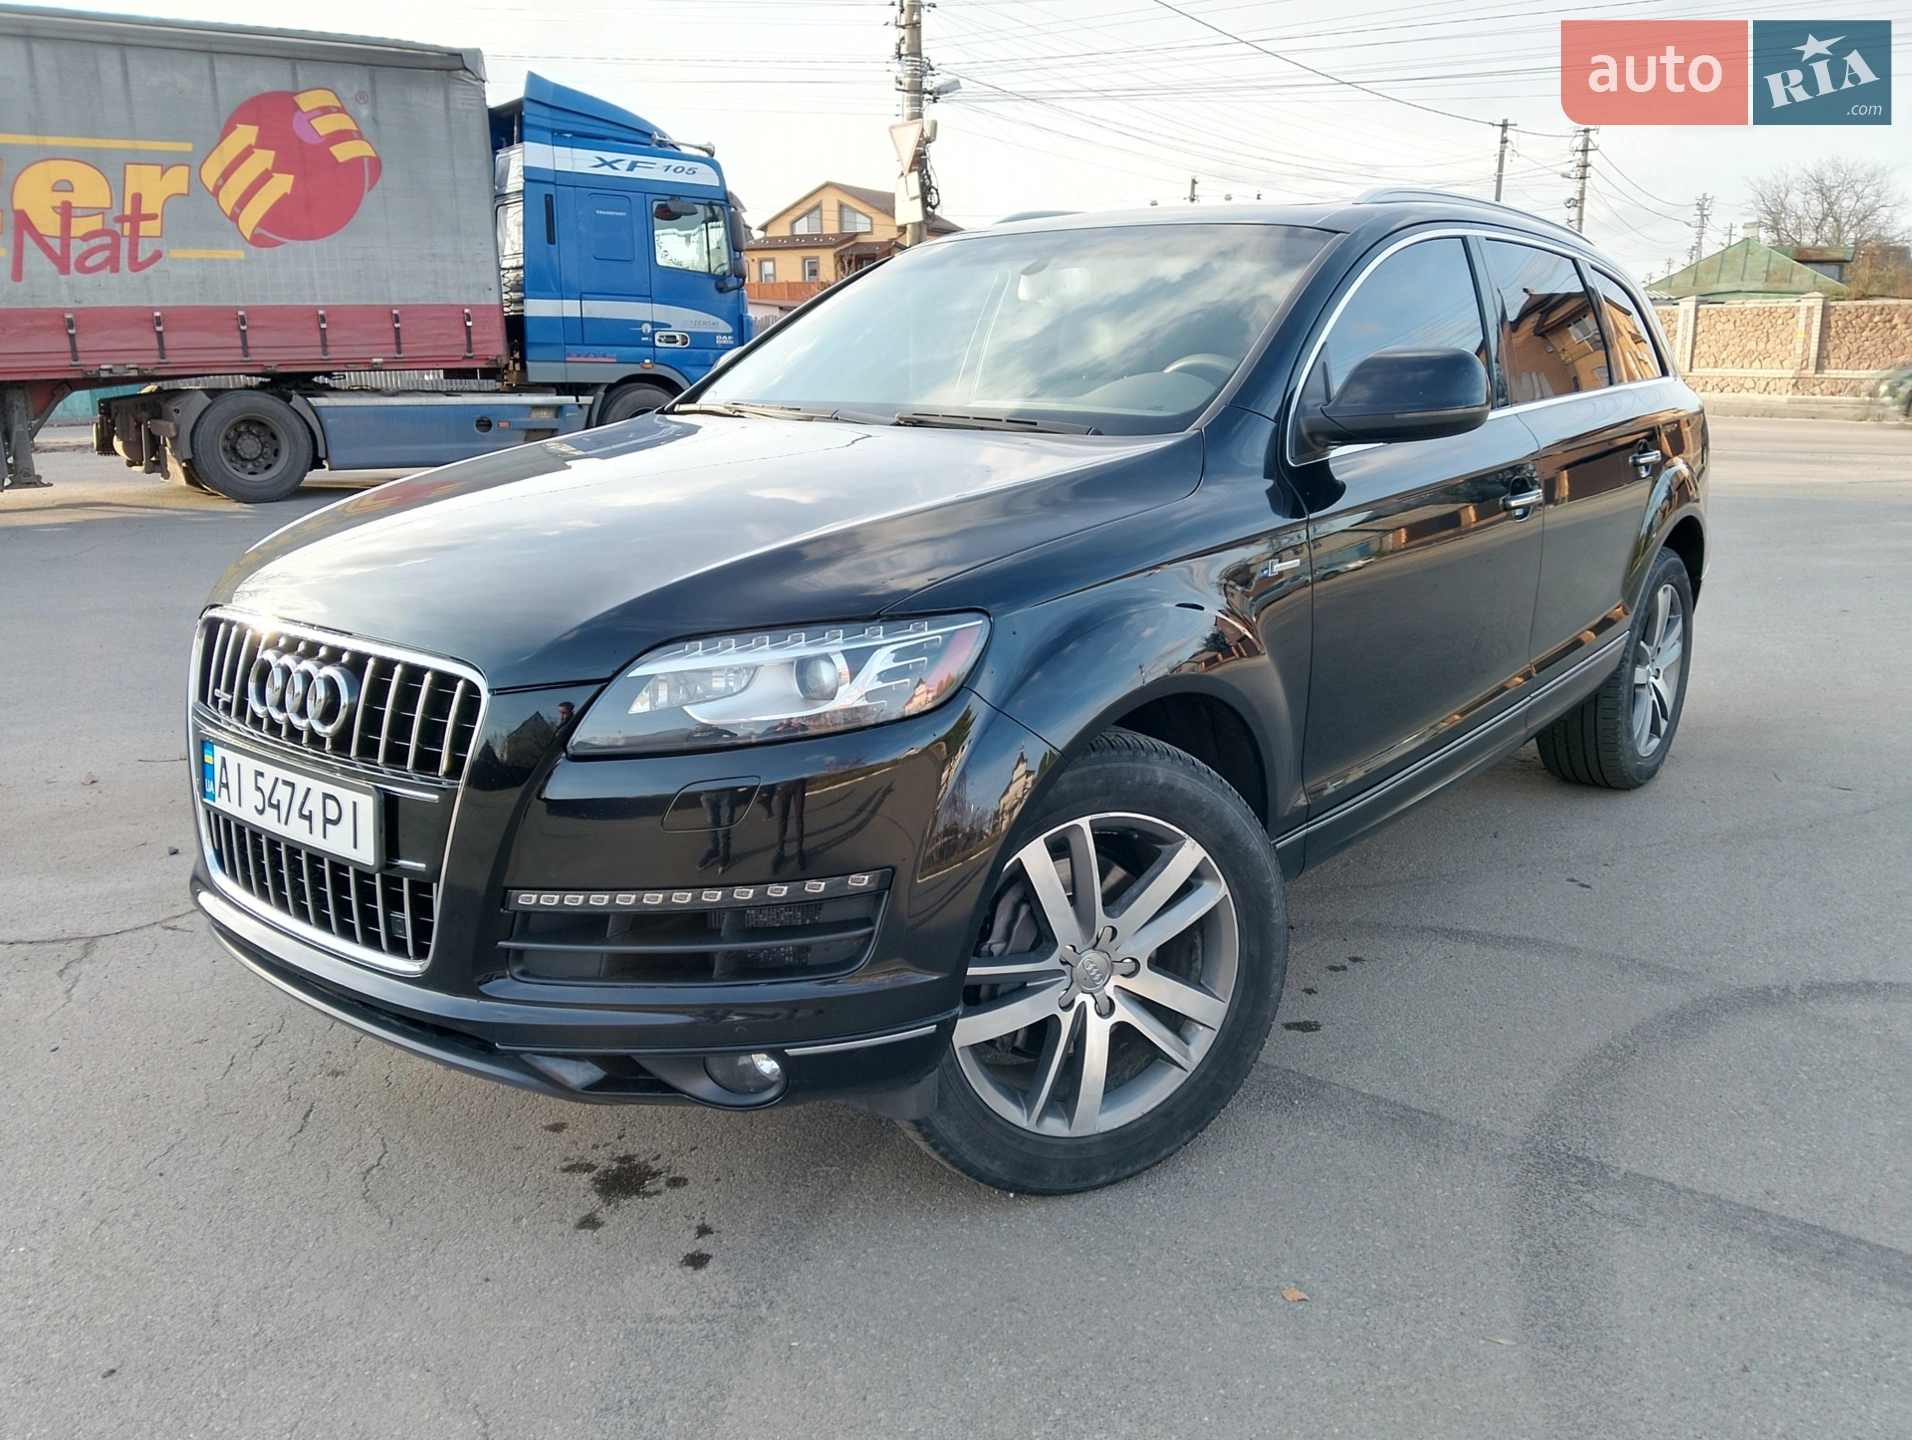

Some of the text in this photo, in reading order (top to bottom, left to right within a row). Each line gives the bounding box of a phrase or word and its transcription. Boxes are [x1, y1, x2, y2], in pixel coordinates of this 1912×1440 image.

[588, 156, 699, 176] XF 105
[0, 157, 192, 238] er
[11, 192, 163, 282] Nat
[205, 778, 215, 794] UA
